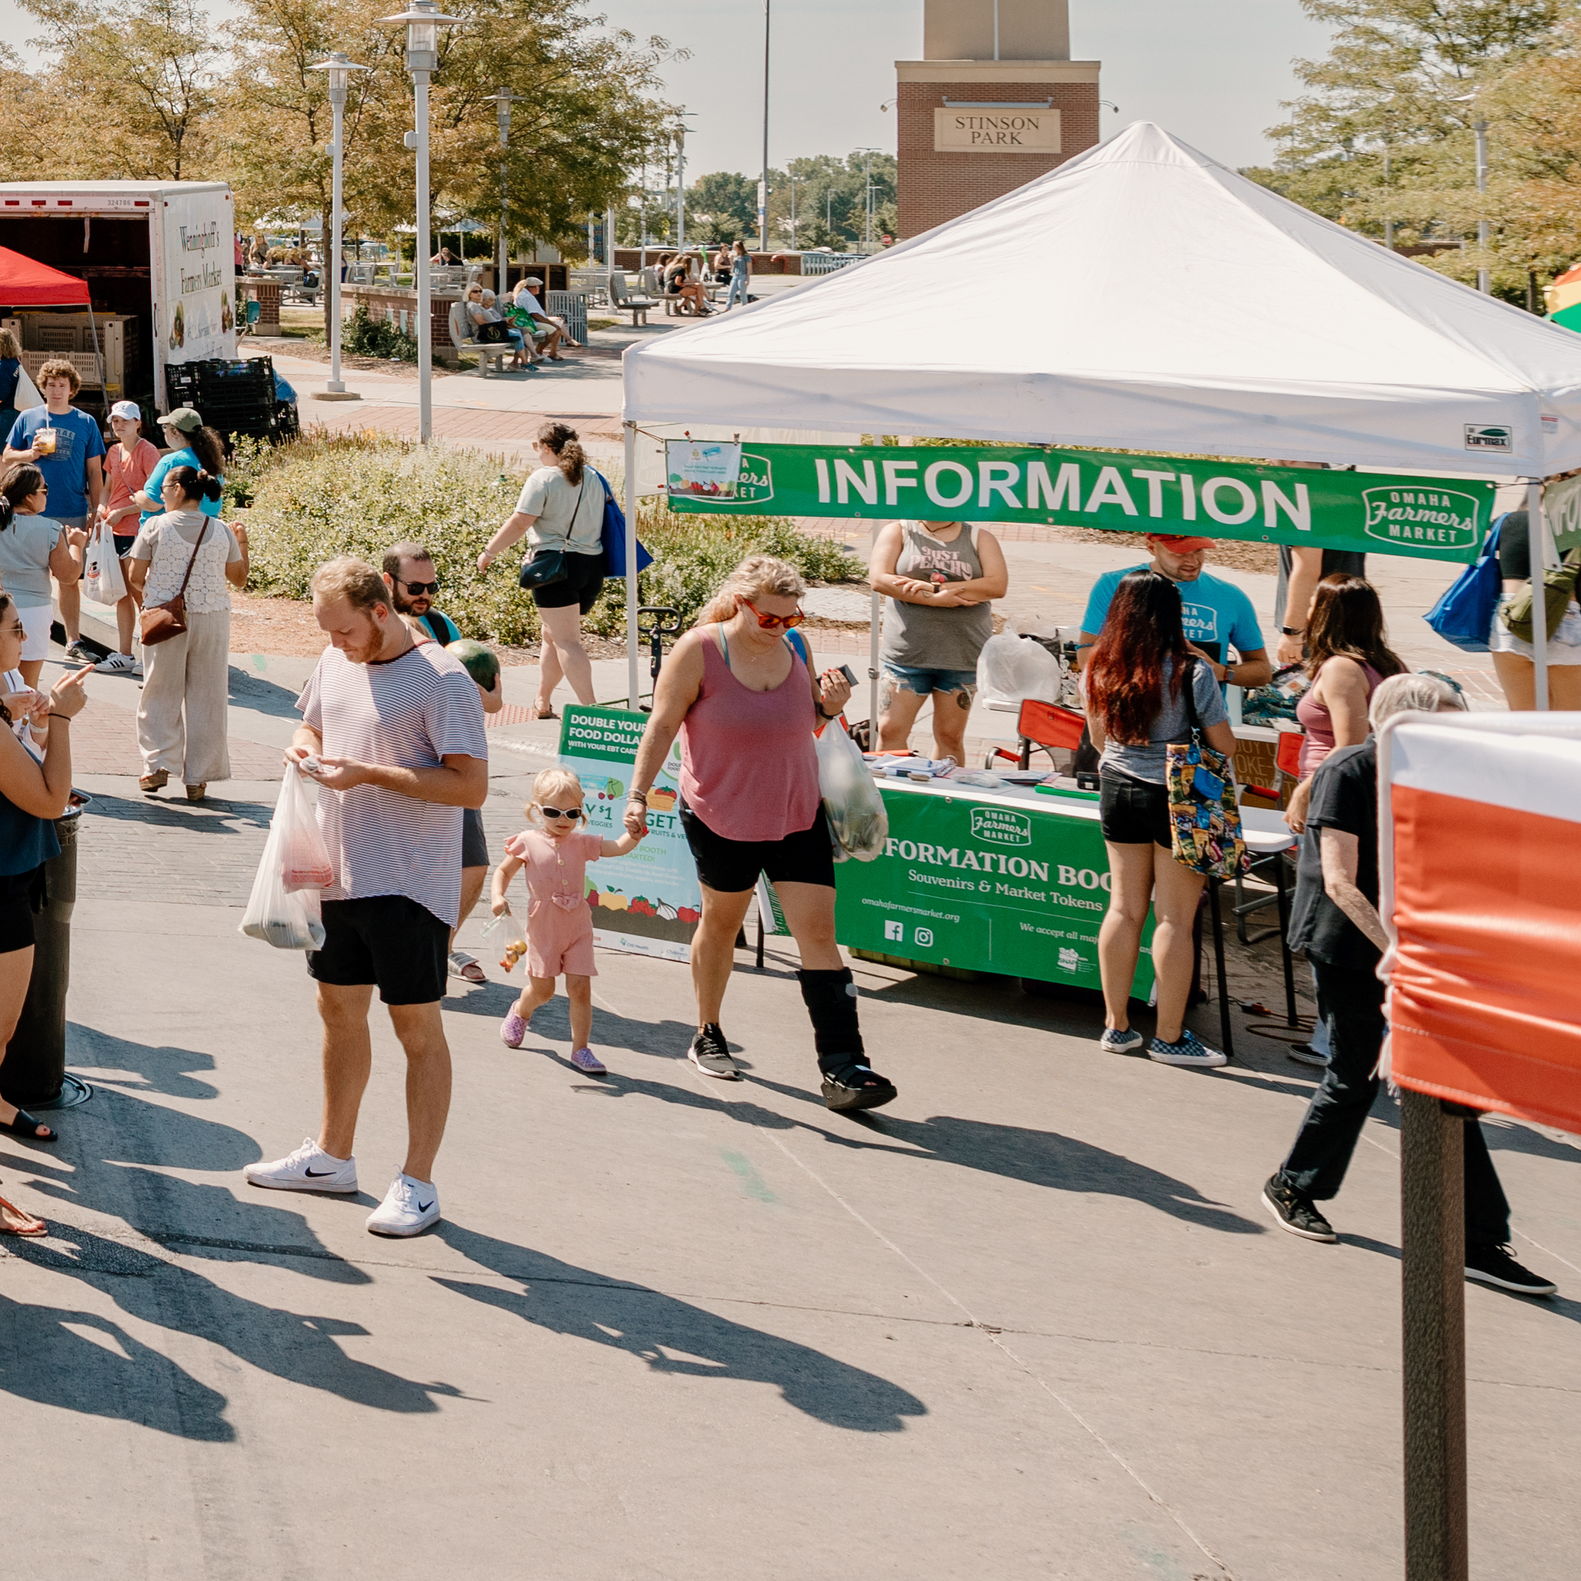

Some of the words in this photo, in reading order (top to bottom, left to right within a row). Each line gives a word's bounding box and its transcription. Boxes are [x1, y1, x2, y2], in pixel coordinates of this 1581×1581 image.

[955, 116, 1040, 131] STINSON
[971, 131, 1023, 145] PARK
[180, 267, 202, 295] Farmers
[202, 260, 223, 290] Market
[1466, 433, 1507, 447] Eurmax
[814, 458, 1313, 532] INFORMATION
[1390, 491, 1452, 508] OMAHA
[1368, 501, 1473, 531] Farmers
[1389, 524, 1458, 543] MARKET
[921, 545, 960, 560] JUST
[906, 554, 973, 582] PEACHY
[570, 713, 616, 730] DOUBLE
[568, 727, 602, 741] FOOD
[568, 739, 586, 749] WITH
[587, 741, 607, 751] YOUR
[607, 744, 620, 754] EBT
[598, 804, 613, 821] $1
[984, 810, 1017, 823] OMAHA
[646, 812, 677, 831] GET
[972, 815, 1028, 838] Farmers
[983, 829, 1021, 843] MARKET
[639, 844, 667, 856] BOOTH
[879, 836, 1050, 883] FORMATION
[907, 869, 975, 892] Souvenirs
[978, 879, 991, 893] &
[994, 881, 1047, 903] Market
[1048, 891, 1103, 912] Tokens
[861, 896, 961, 923] omahafarmersmarket.org
[1019, 921, 1034, 932] We
[1035, 925, 1064, 940] accept
[1065, 931, 1078, 940] all
